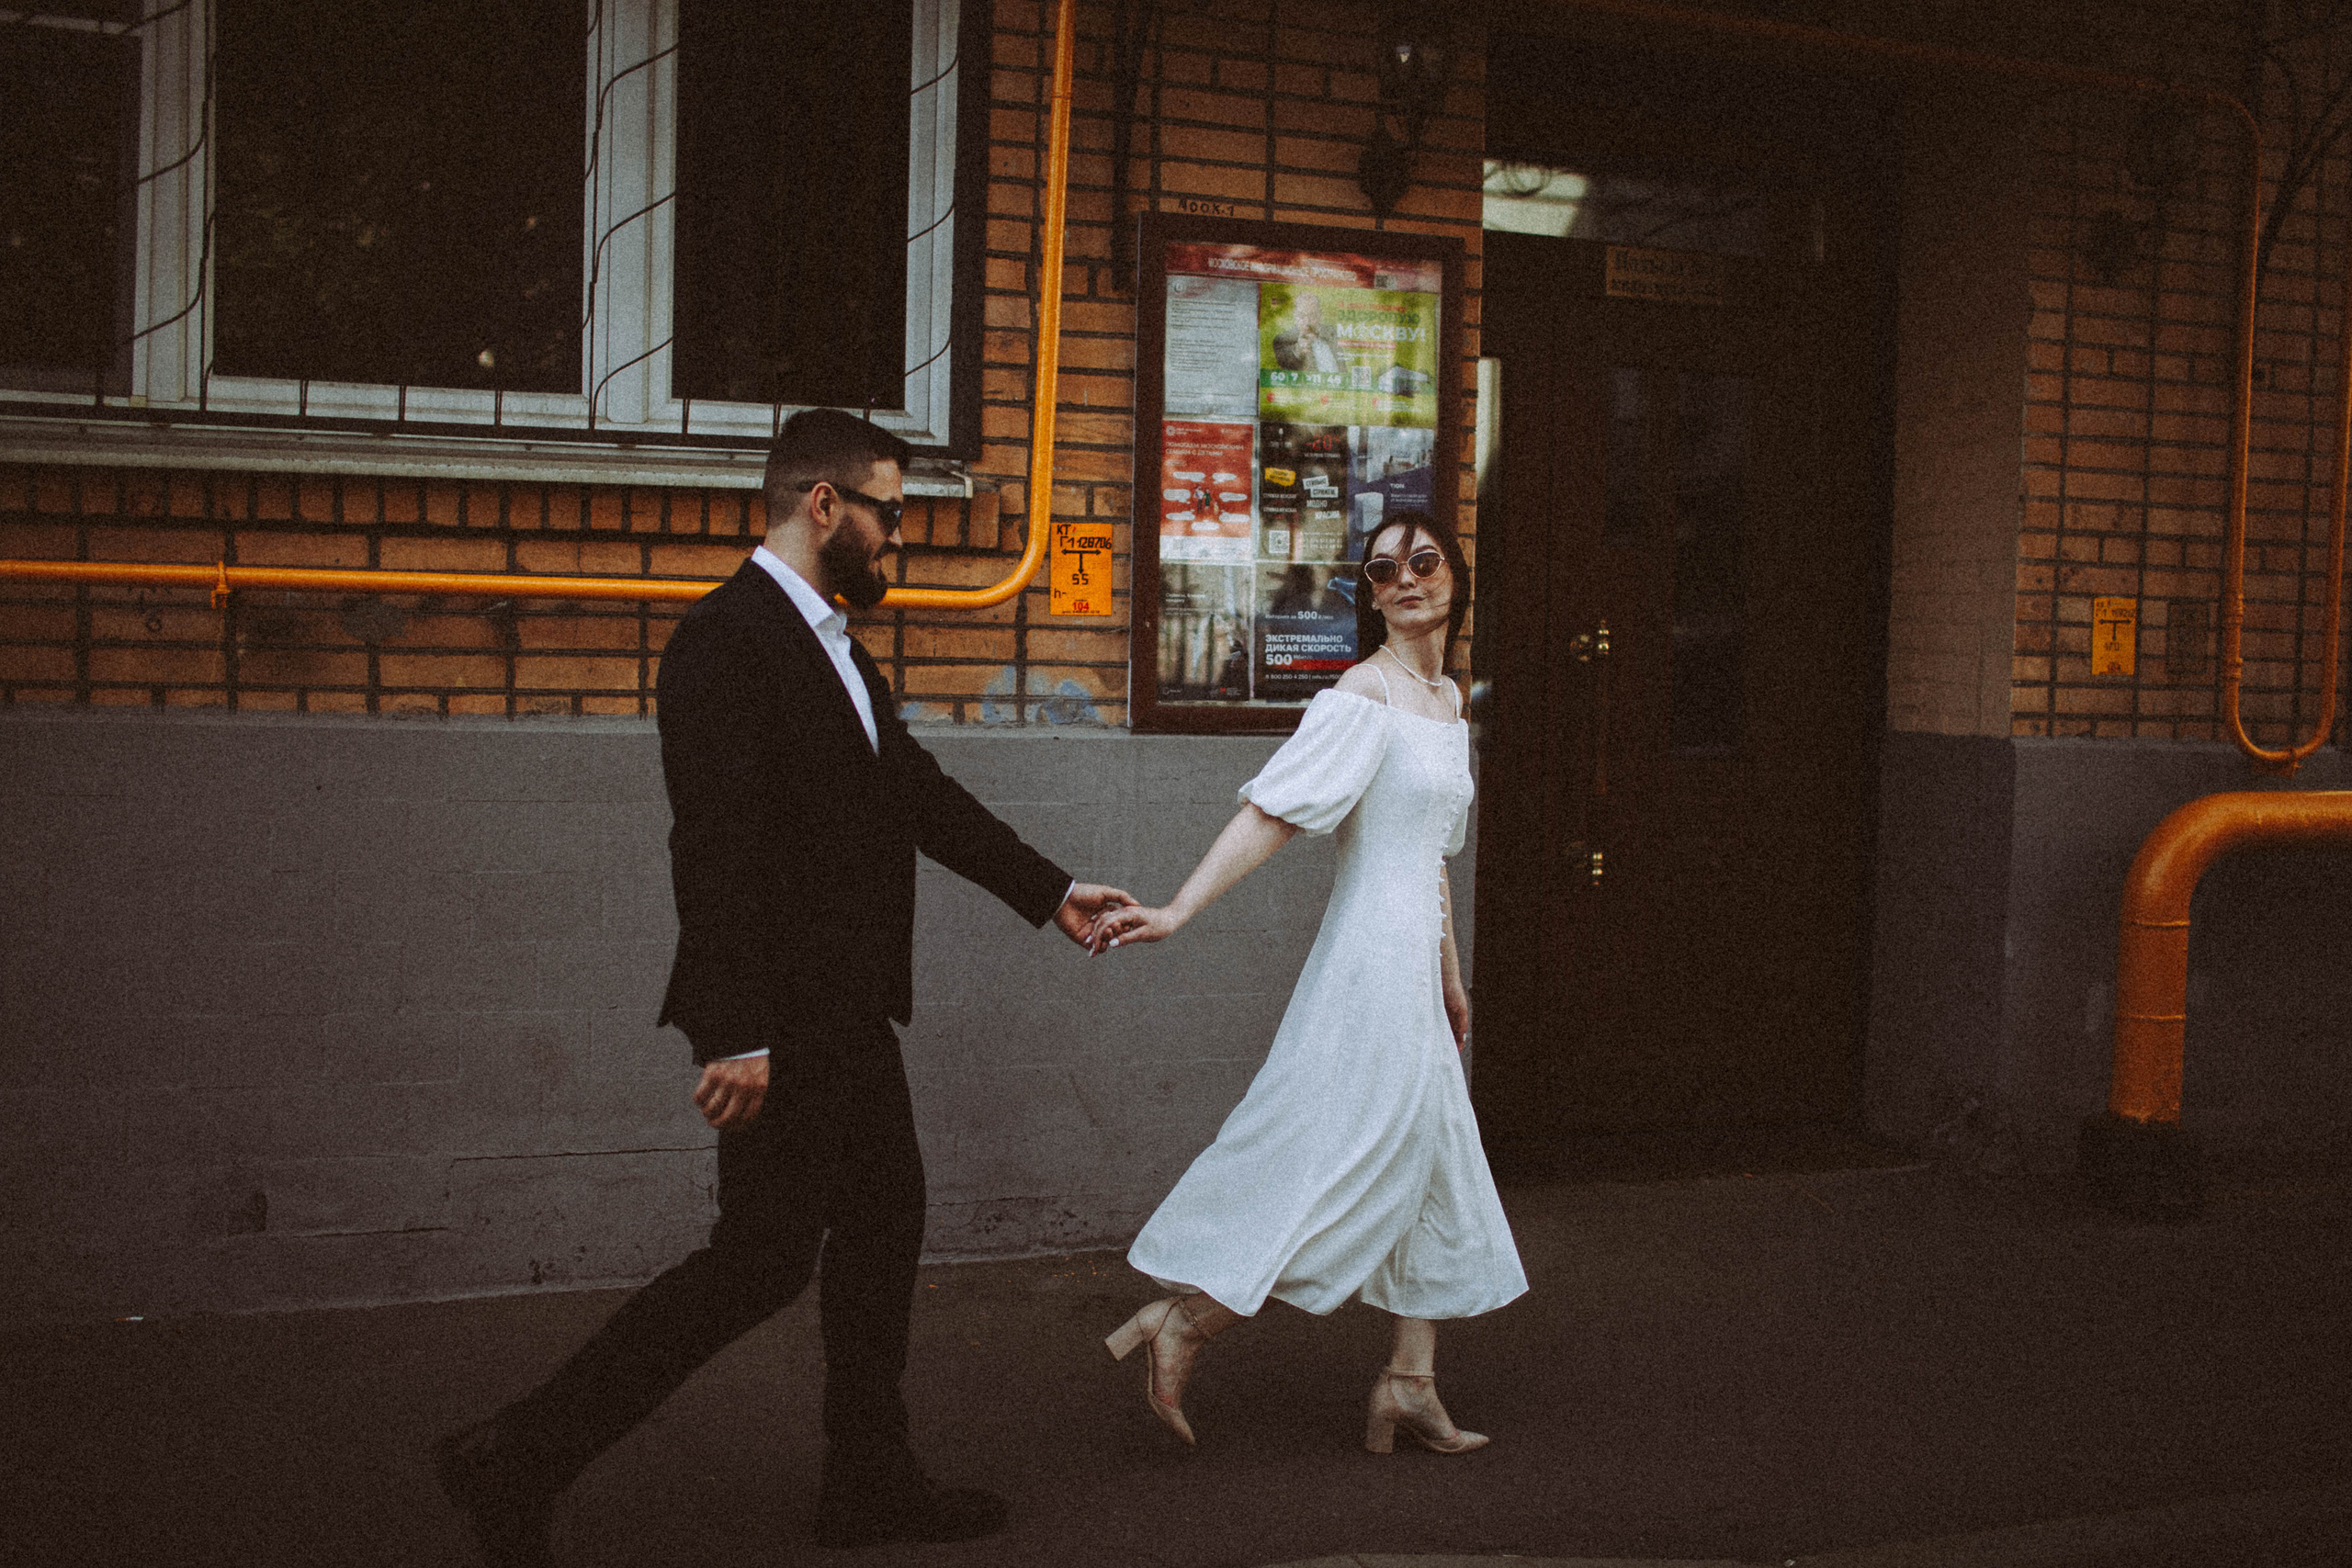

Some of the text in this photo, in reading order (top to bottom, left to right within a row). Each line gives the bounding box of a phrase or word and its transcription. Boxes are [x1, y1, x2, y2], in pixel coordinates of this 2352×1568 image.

[1072, 602, 1091, 611] 104
[1297, 611, 1317, 620] 500
[1265, 634, 1343, 643] ЭКСТРЕМАЛЬНО
[1265, 644, 1352, 653] ДИКАЯ СКОРОСТЬ
[1265, 654, 1293, 666] 500
